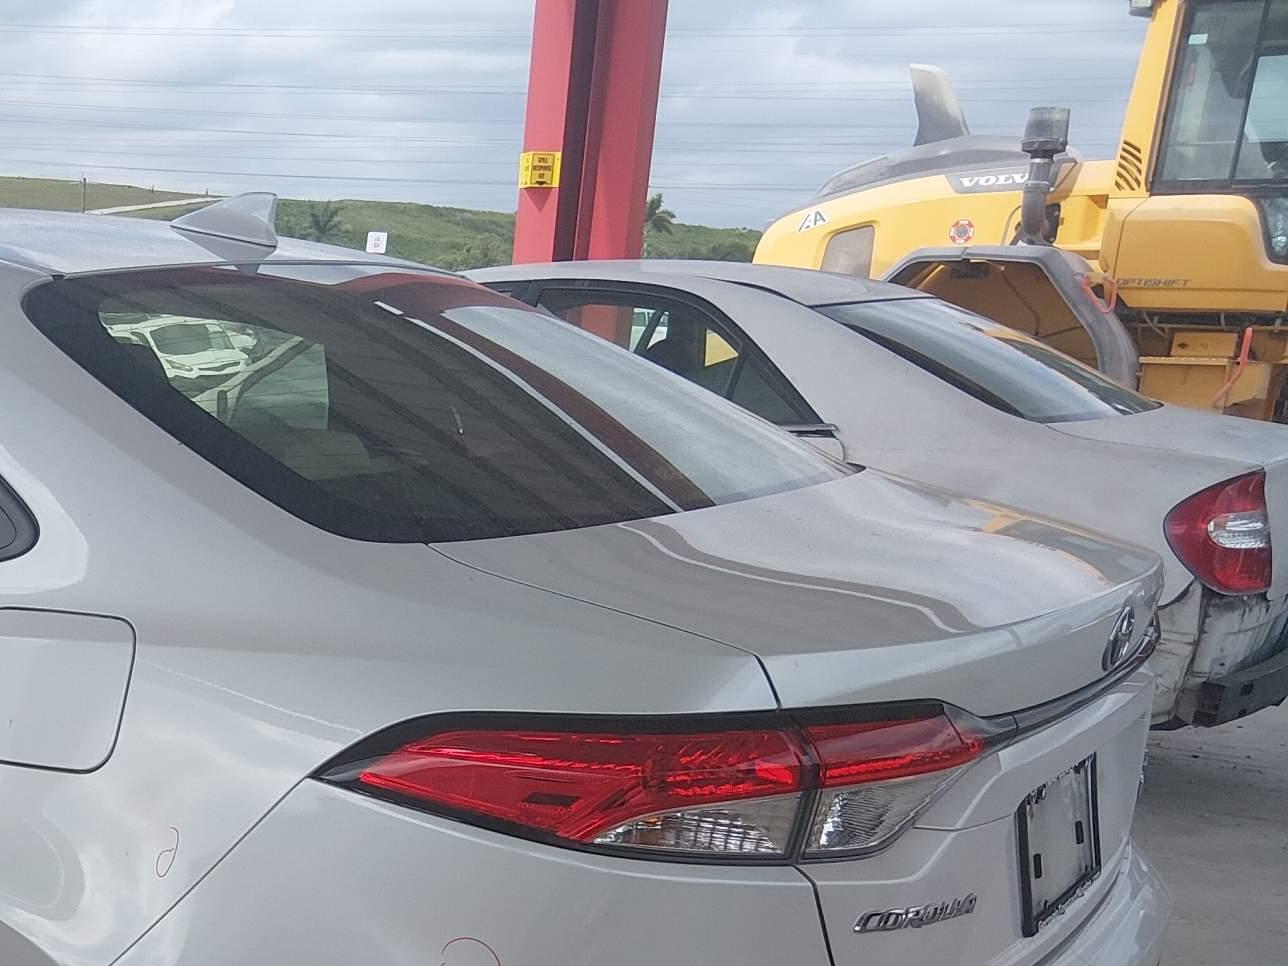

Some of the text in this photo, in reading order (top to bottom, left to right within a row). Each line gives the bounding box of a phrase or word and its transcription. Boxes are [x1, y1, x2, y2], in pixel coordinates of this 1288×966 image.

[959, 173, 1029, 188] VOLV
[1116, 277, 1192, 288] OPTISHIFT
[853, 892, 978, 933] COROLLA
